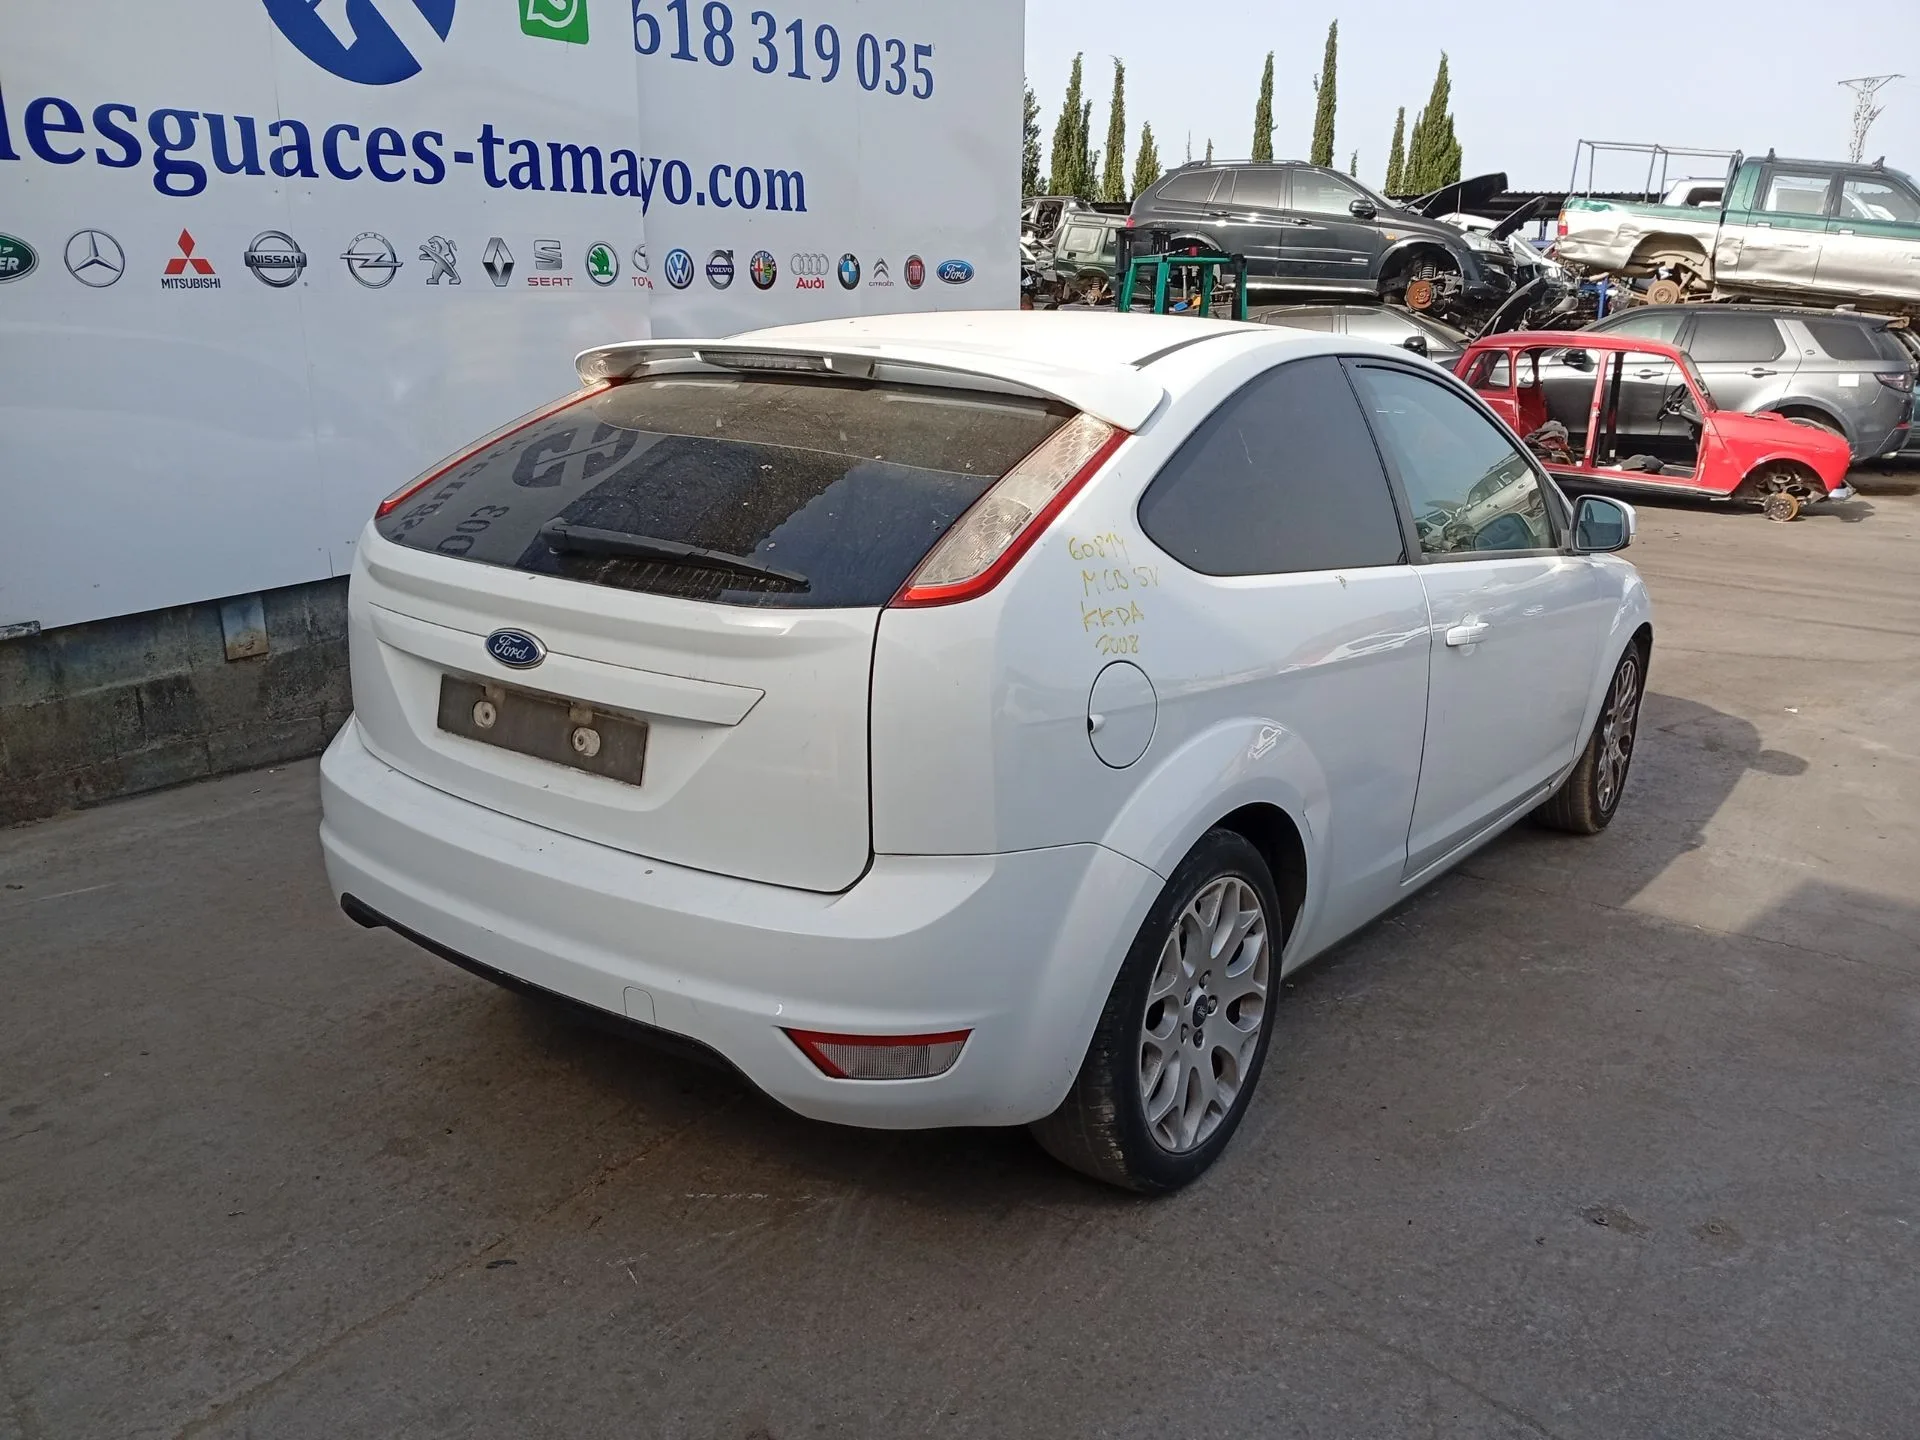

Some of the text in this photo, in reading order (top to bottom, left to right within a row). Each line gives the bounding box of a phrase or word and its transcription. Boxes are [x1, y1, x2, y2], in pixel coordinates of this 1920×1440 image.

[632, 0, 934, 100] 618 319 035
[0, 86, 808, 218] esguaces-tamayo.com
[250, 254, 301, 264] NISSAN
[707, 266, 733, 274] VOLVO
[944, 263, 967, 280] Ford
[161, 278, 221, 289] MITSUBISHI
[527, 277, 573, 287] SEAT
[796, 277, 825, 289] Audi
[494, 635, 529, 660] Ford
